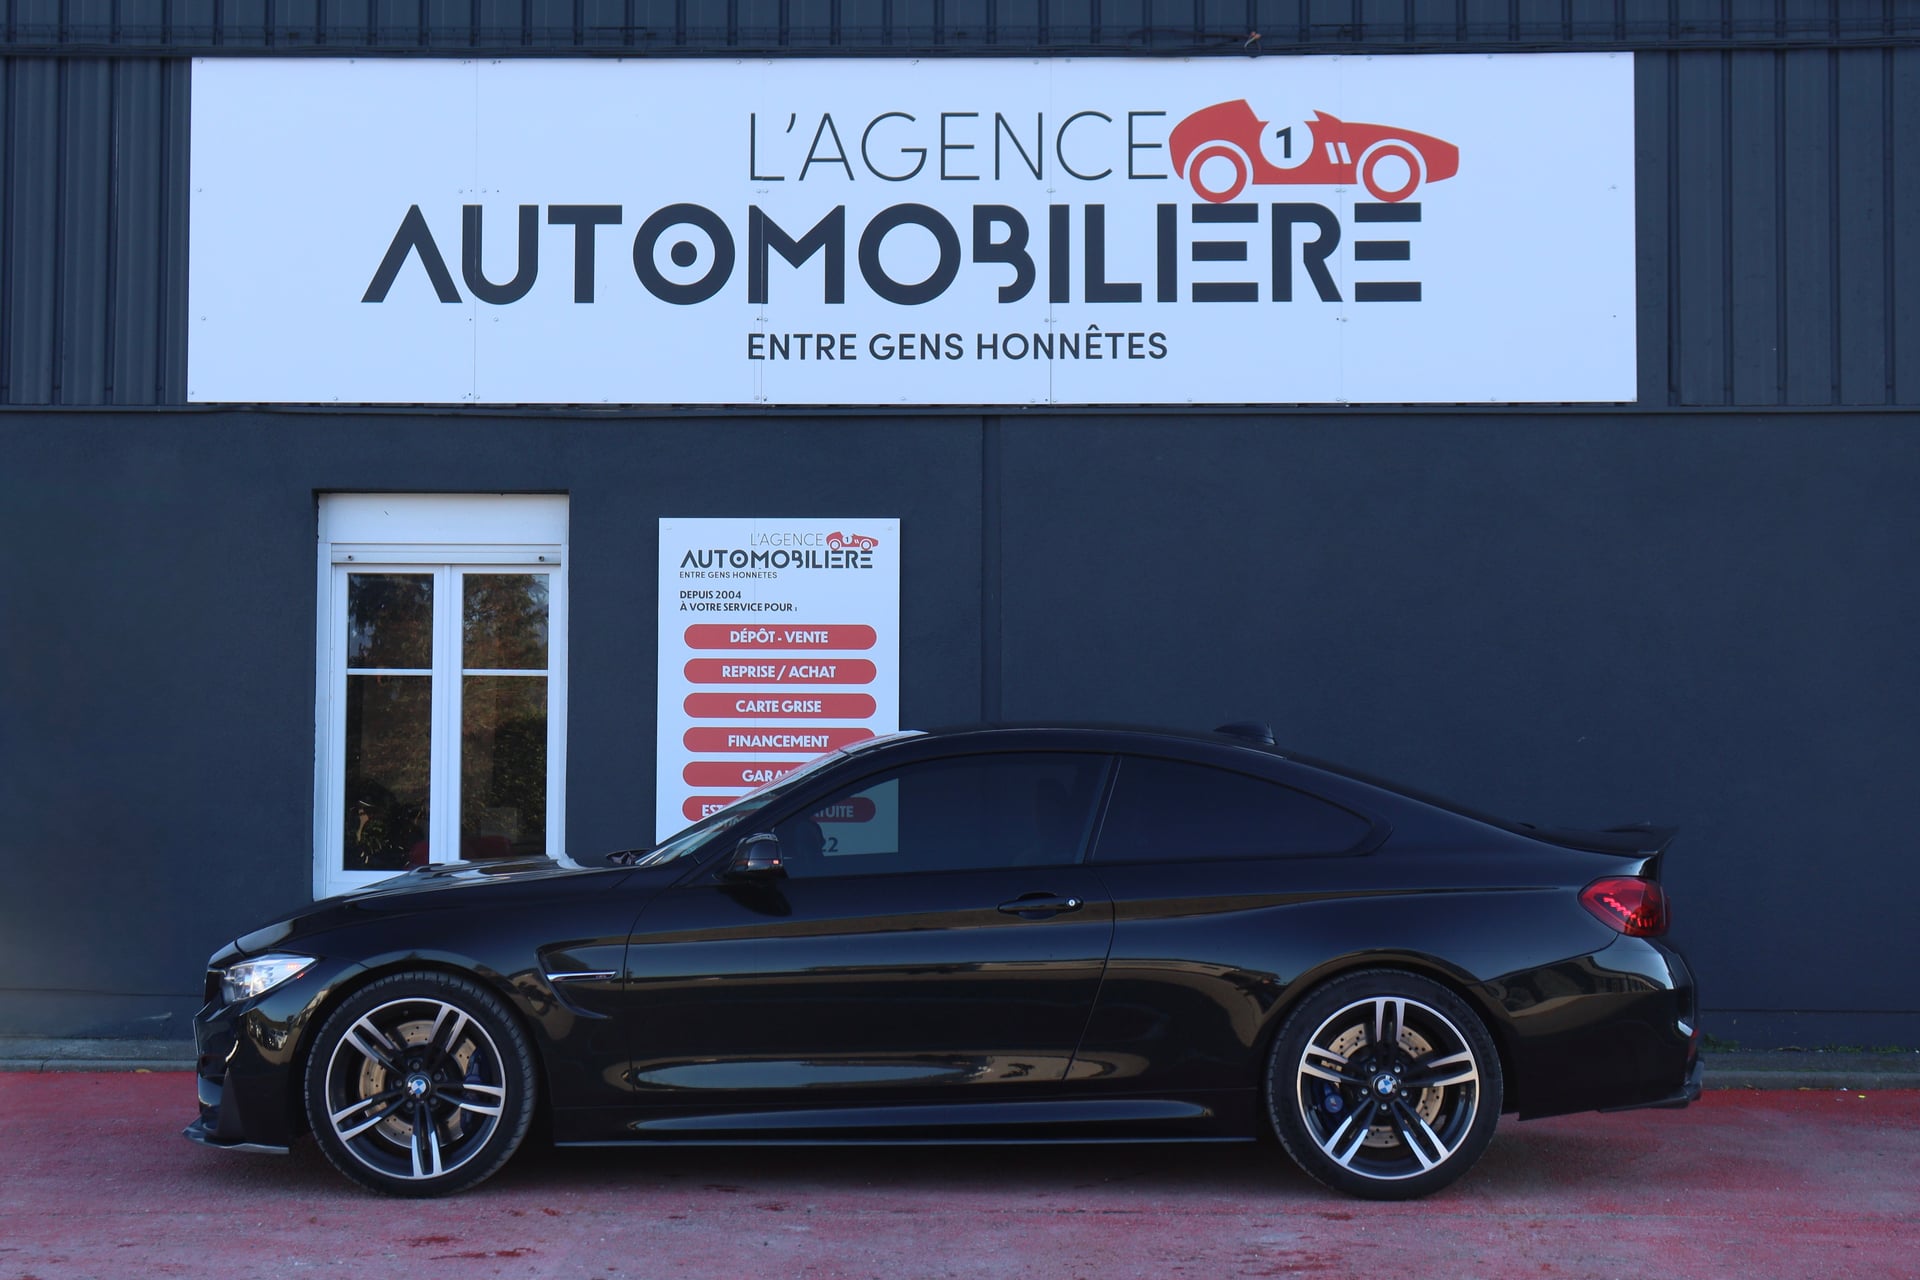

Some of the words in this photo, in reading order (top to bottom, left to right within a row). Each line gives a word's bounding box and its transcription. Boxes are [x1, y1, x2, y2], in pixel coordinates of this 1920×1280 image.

[749, 111, 1168, 182] L'AGENCE
[1274, 126, 1292, 159] 1
[360, 202, 1422, 306] AUTOMOBILIERE
[748, 333, 857, 361] ENTRE
[868, 332, 964, 361] GENS
[977, 324, 1168, 361] HONNÊTES
[750, 532, 823, 547] L'AGENCE
[679, 571, 706, 579] ENTRE
[707, 571, 731, 579] GENS
[679, 590, 714, 600] DEPUIS
[715, 590, 742, 600] 2004
[679, 600, 688, 612] À
[689, 602, 722, 612] VOTRE
[723, 602, 763, 612] SERVICE
[764, 602, 793, 612] POUR
[730, 627, 775, 644] DÉPÔT
[784, 631, 829, 644] VENTE
[722, 665, 776, 678] REPRISE
[788, 665, 837, 678] ACHAT
[735, 700, 780, 713] CARTE
[781, 700, 822, 713] GRISE
[728, 735, 830, 748] FINANCEMENT
